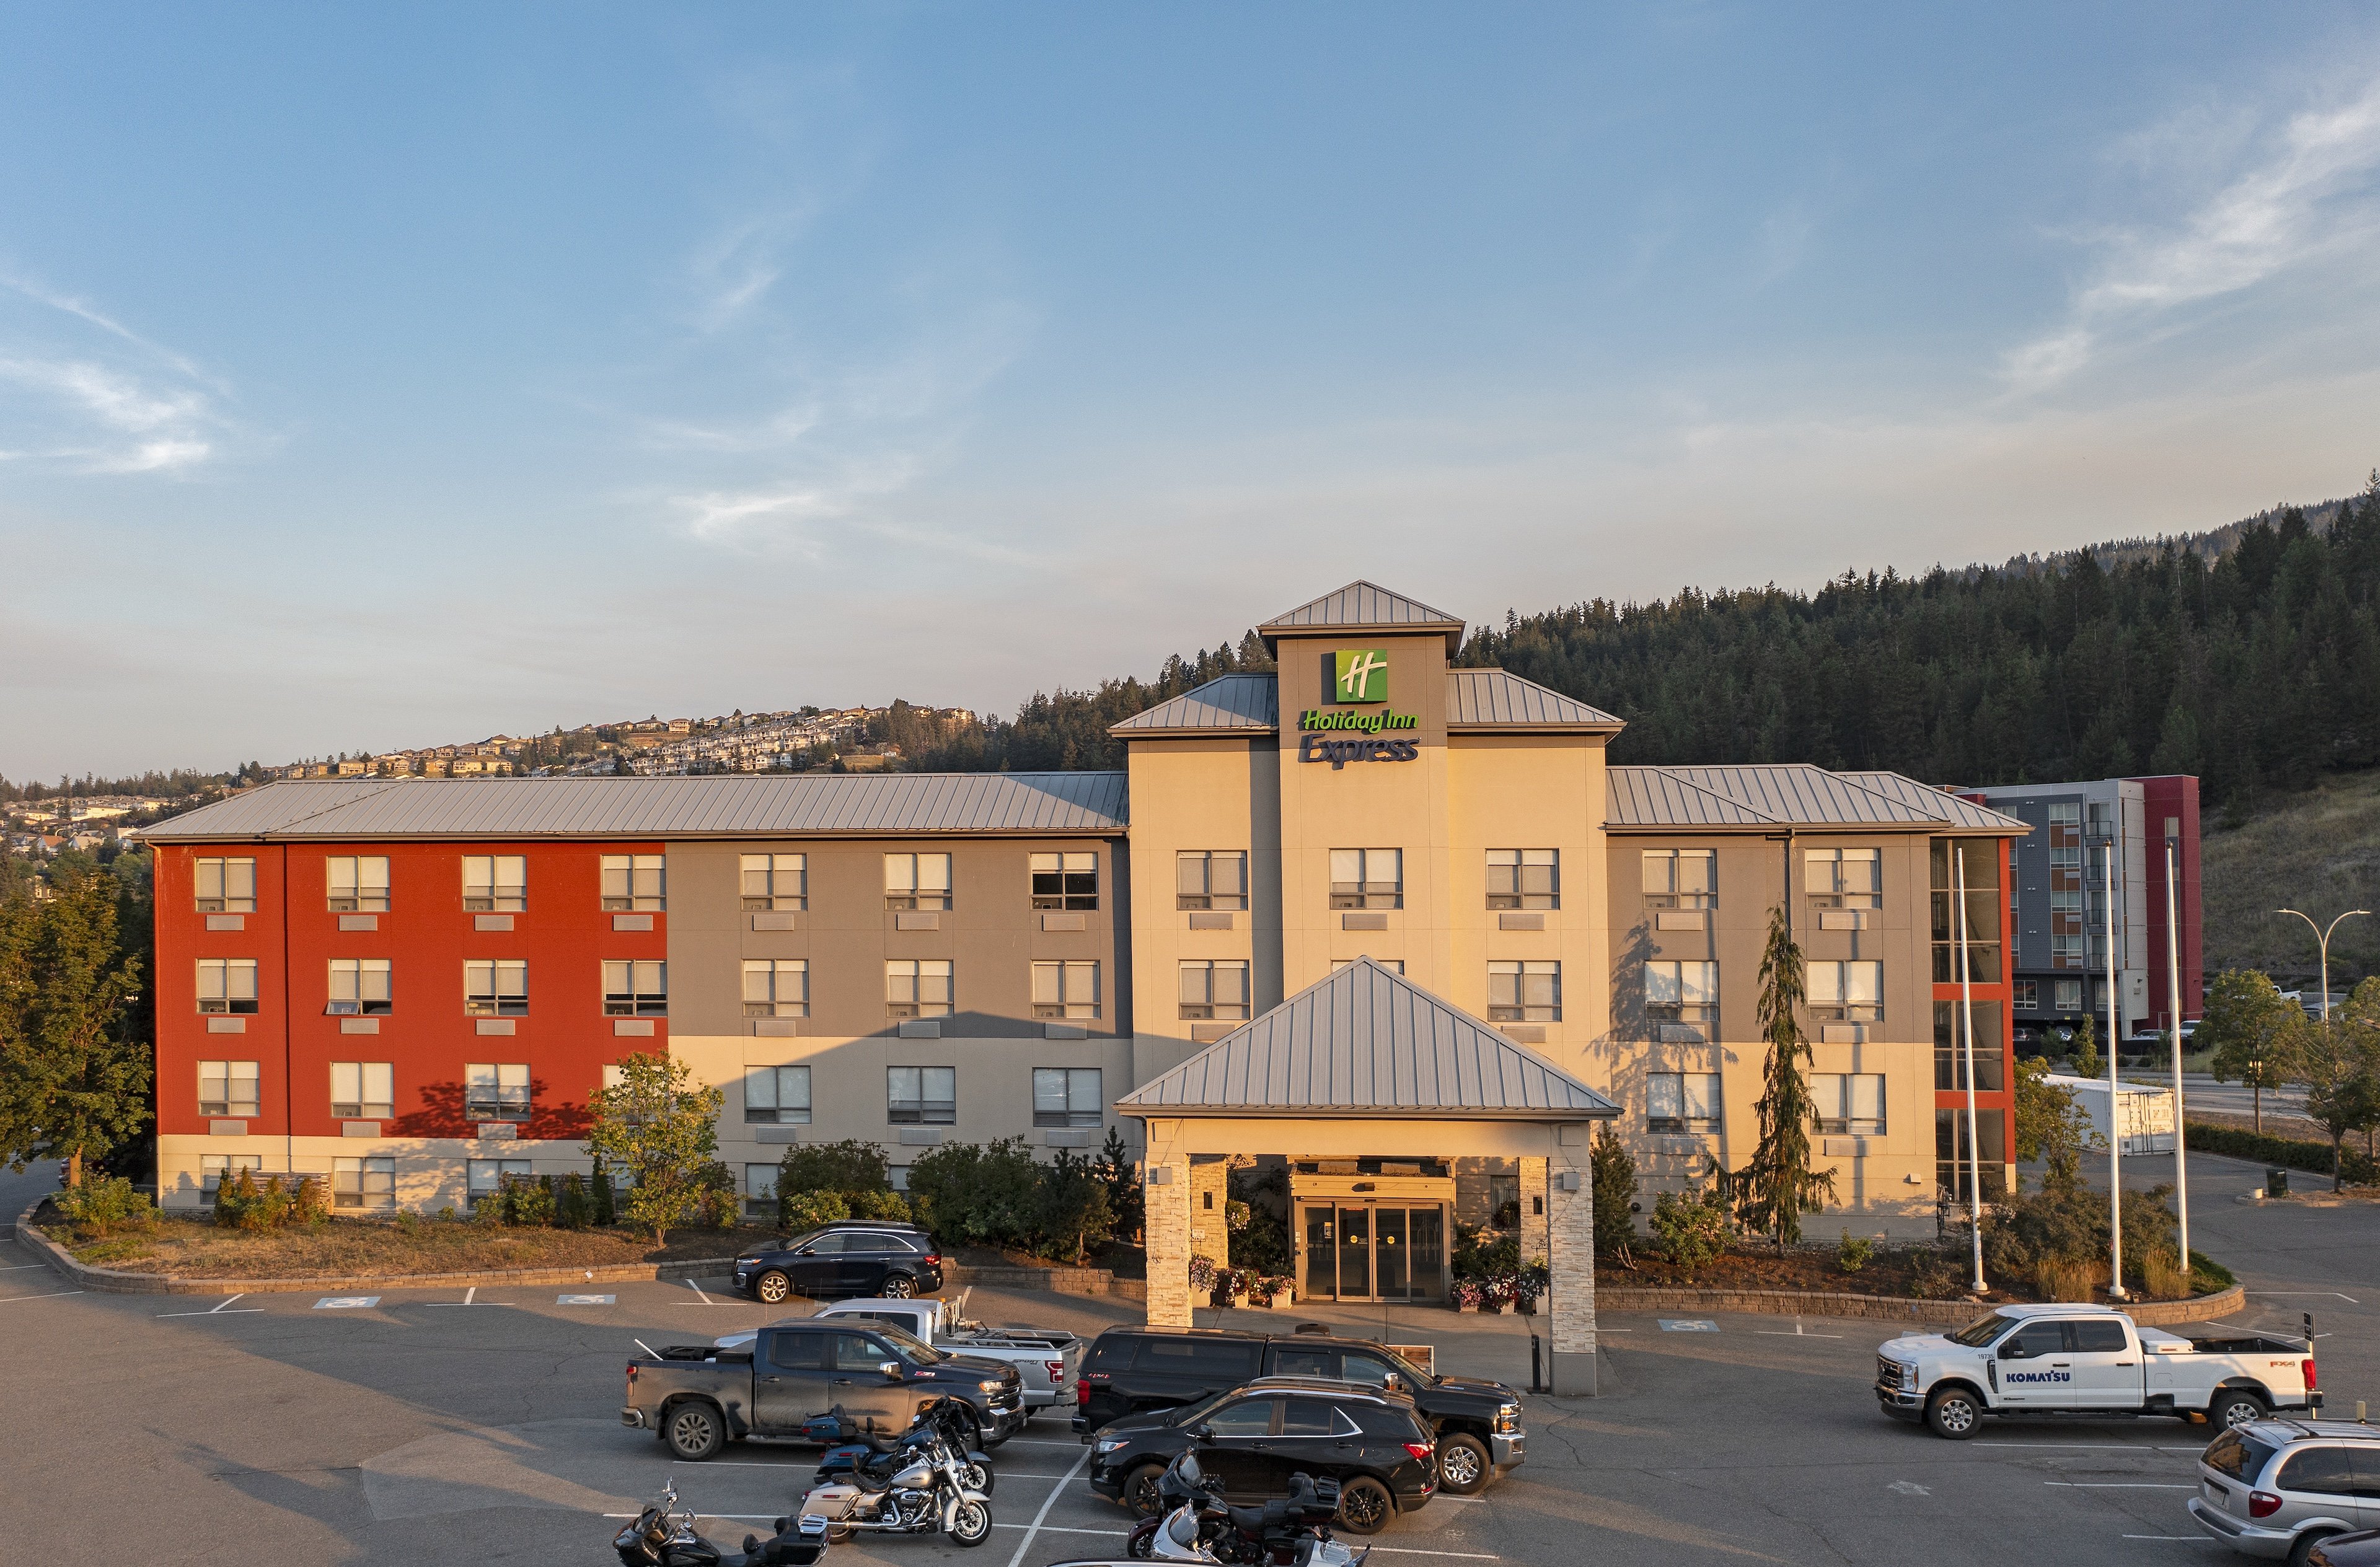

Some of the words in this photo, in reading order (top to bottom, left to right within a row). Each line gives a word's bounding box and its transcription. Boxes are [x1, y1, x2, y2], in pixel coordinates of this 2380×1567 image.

[1303, 709, 1385, 734] Holiday
[1386, 708, 1419, 729] Inn
[1305, 733, 1420, 770] Express
[2006, 1370, 2071, 1383] KOMATSU
